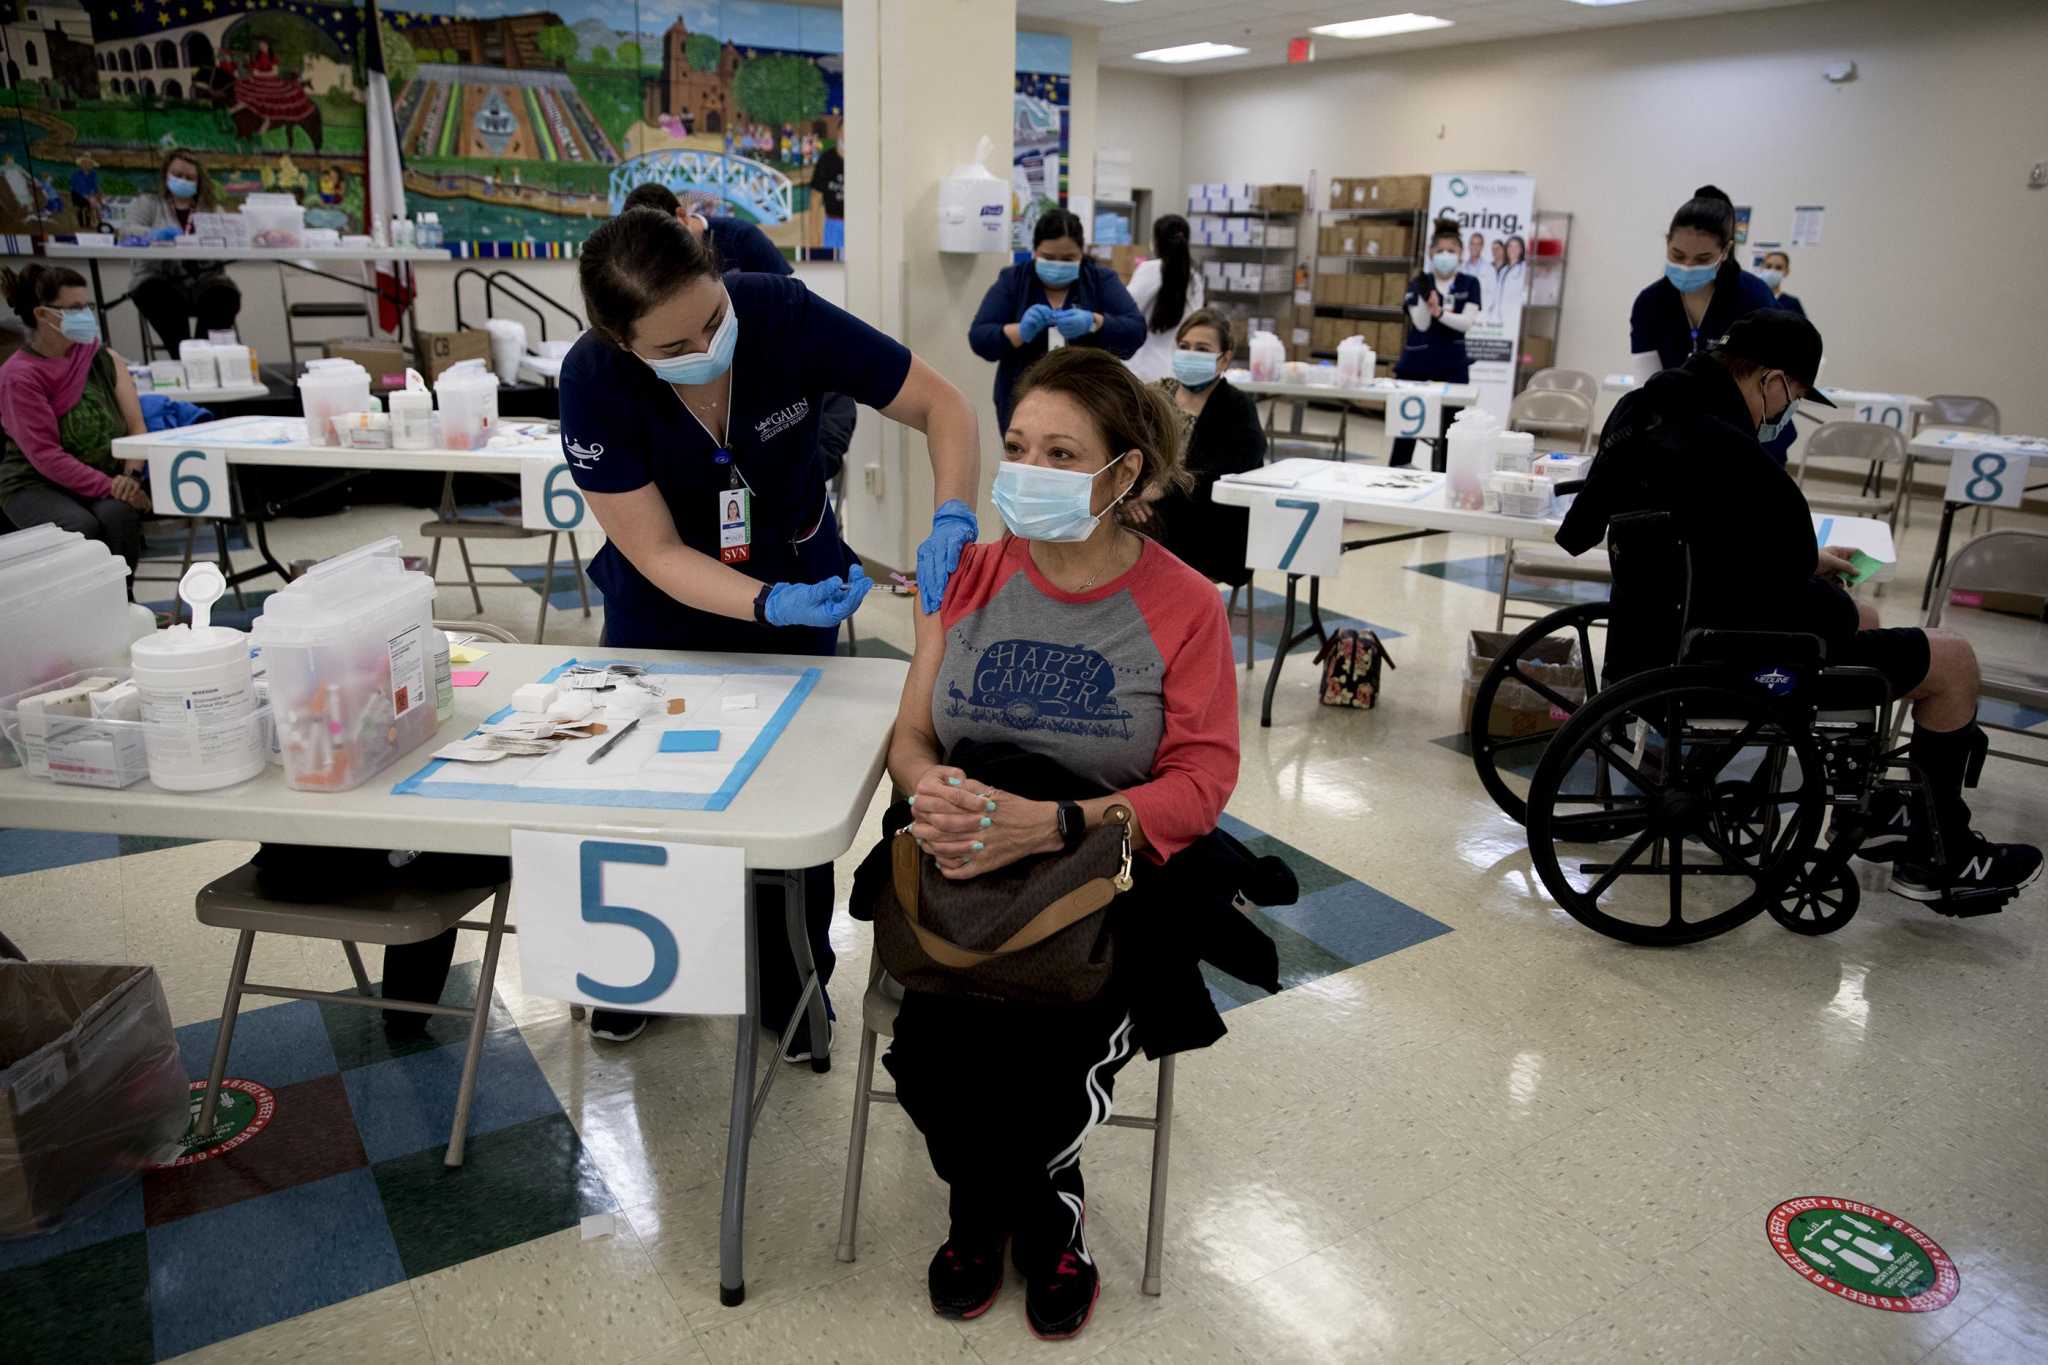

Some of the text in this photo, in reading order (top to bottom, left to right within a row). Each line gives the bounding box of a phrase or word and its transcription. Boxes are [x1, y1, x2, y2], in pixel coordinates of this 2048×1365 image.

[1439, 206, 1523, 234] Caring.
[770, 397, 808, 424] GALEN
[1401, 396, 1425, 436] 9
[1860, 406, 1903, 430] 10
[170, 449, 210, 514] 6
[1965, 452, 2008, 503] 8
[543, 464, 584, 529] 6
[1275, 498, 1320, 571] 7
[724, 546, 747, 561] SVN
[988, 643, 1105, 681] HAPPY
[977, 668, 1099, 713] CAMPER
[576, 839, 680, 1005] 5
[240, 1081, 264, 1096] FEET
[259, 1102, 273, 1119] FEET
[221, 1132, 252, 1152] FEET
[1783, 1198, 1818, 1215] 6 FEET
[1832, 1199, 1881, 1217] 6 FEET
[1770, 1215, 1786, 1244] 6 FEET
[1892, 1220, 1938, 1250] 6 FEET
[1783, 1251, 1825, 1283] 6 FEET
[1839, 1287, 1893, 1308] 6 FEET
